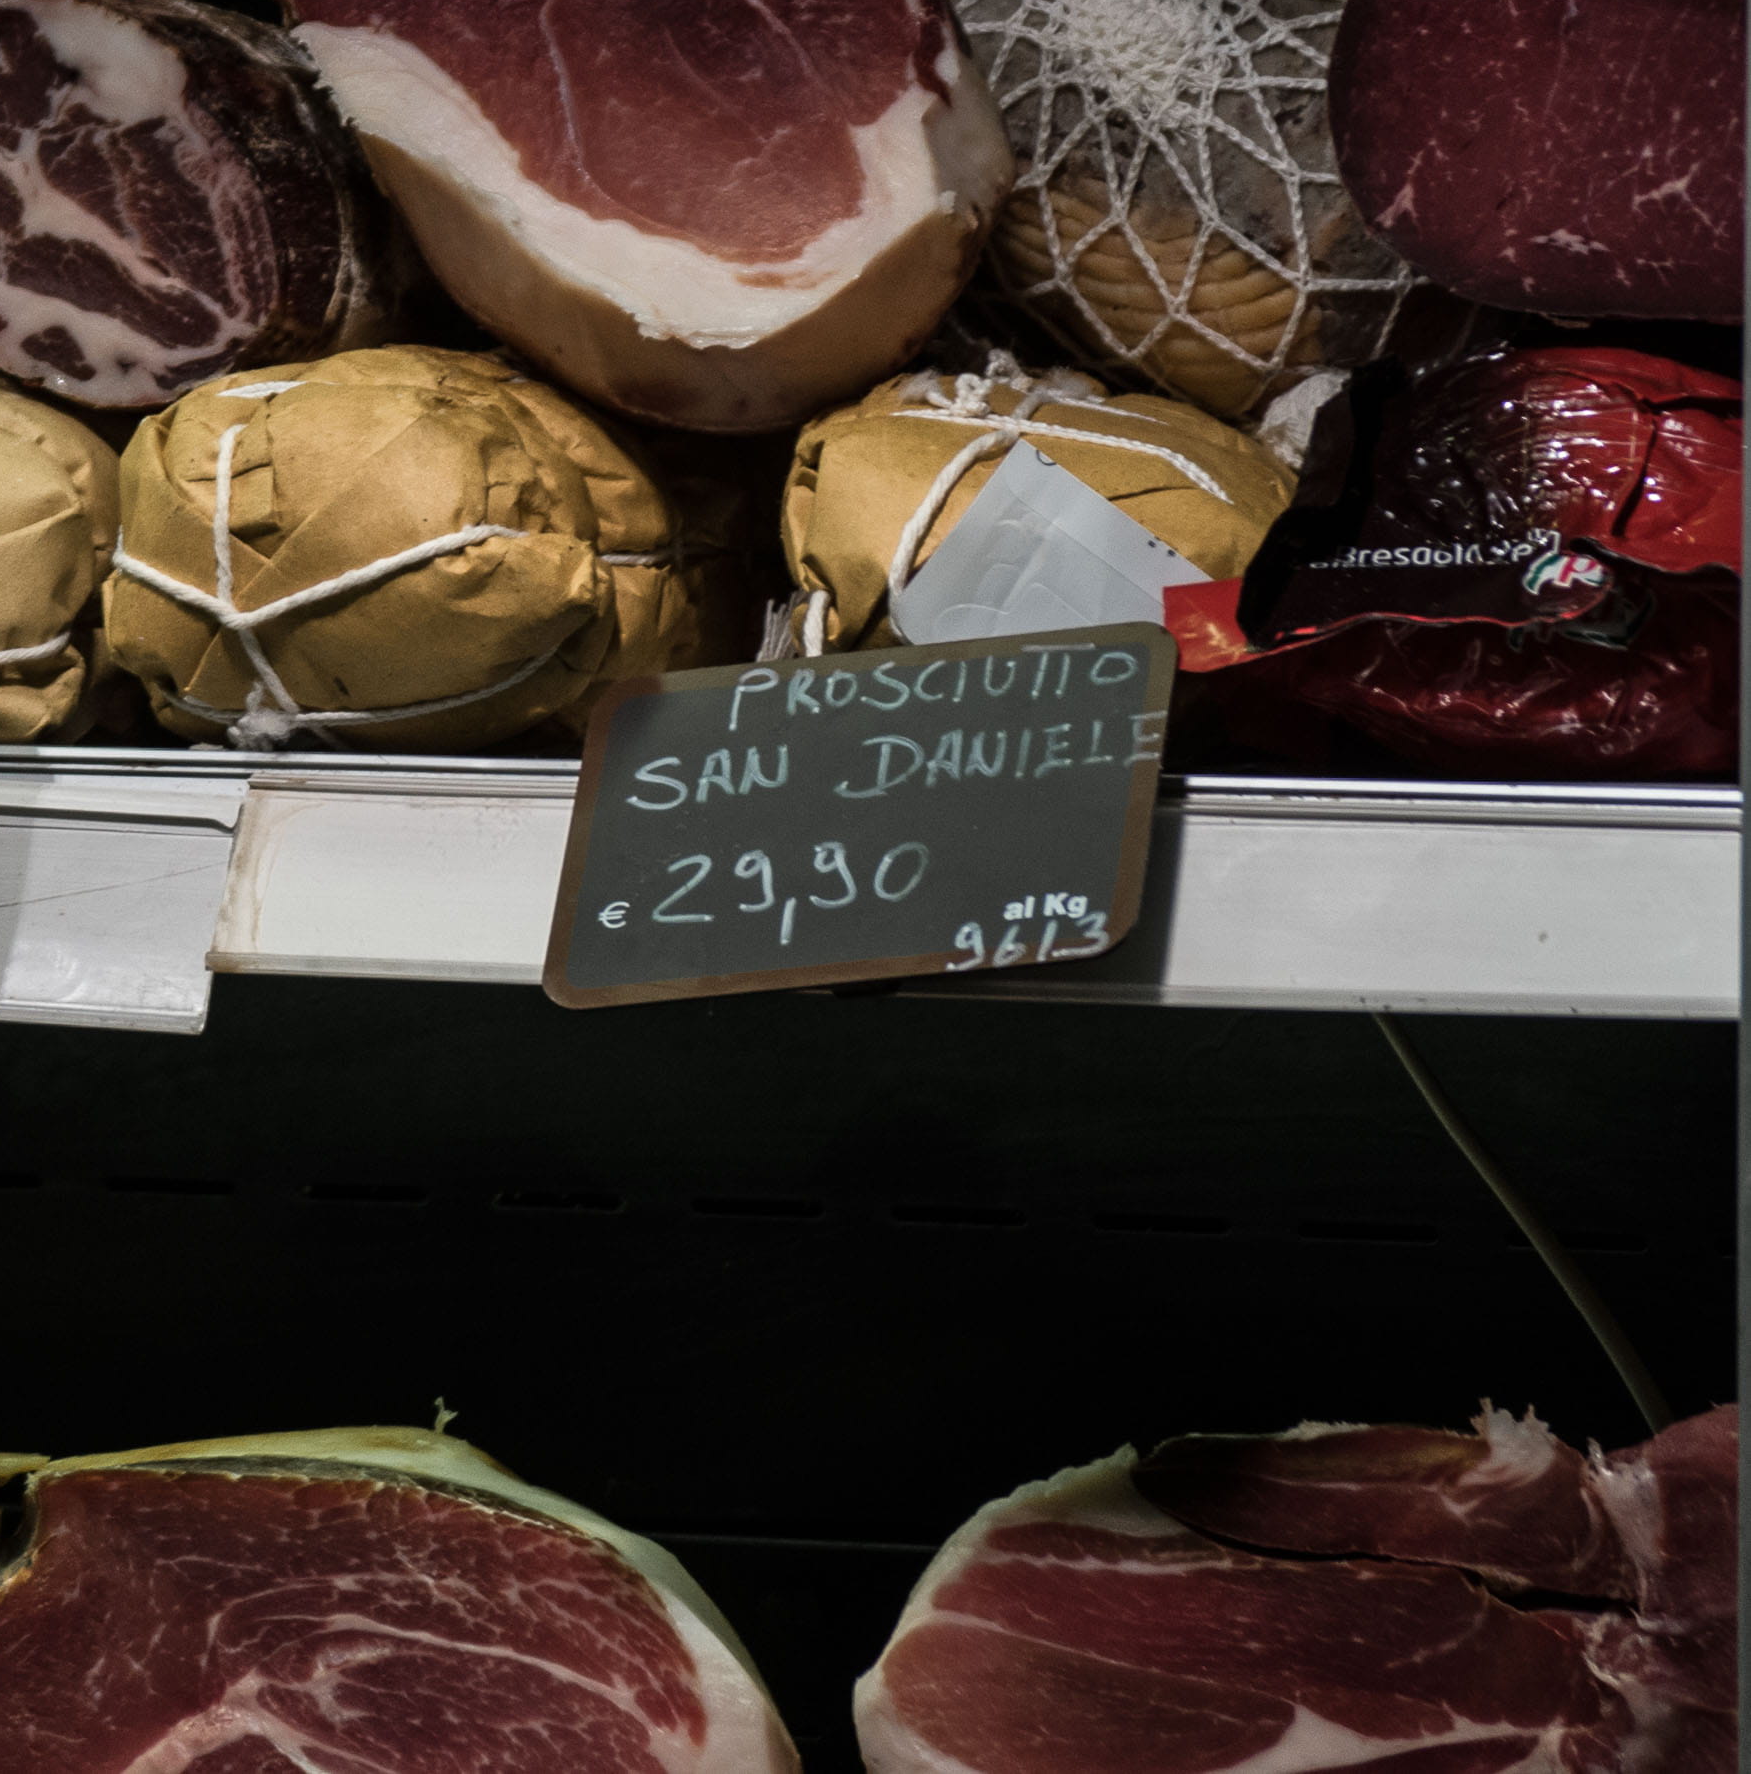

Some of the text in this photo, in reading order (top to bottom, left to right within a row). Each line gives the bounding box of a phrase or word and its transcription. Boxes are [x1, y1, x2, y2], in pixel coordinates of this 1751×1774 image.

[729, 642, 1139, 731] PROSCIUTTO
[626, 710, 1169, 812] SAN DANIELE
[599, 840, 931, 947] € 29,90
[1003, 892, 1089, 921] al Kg
